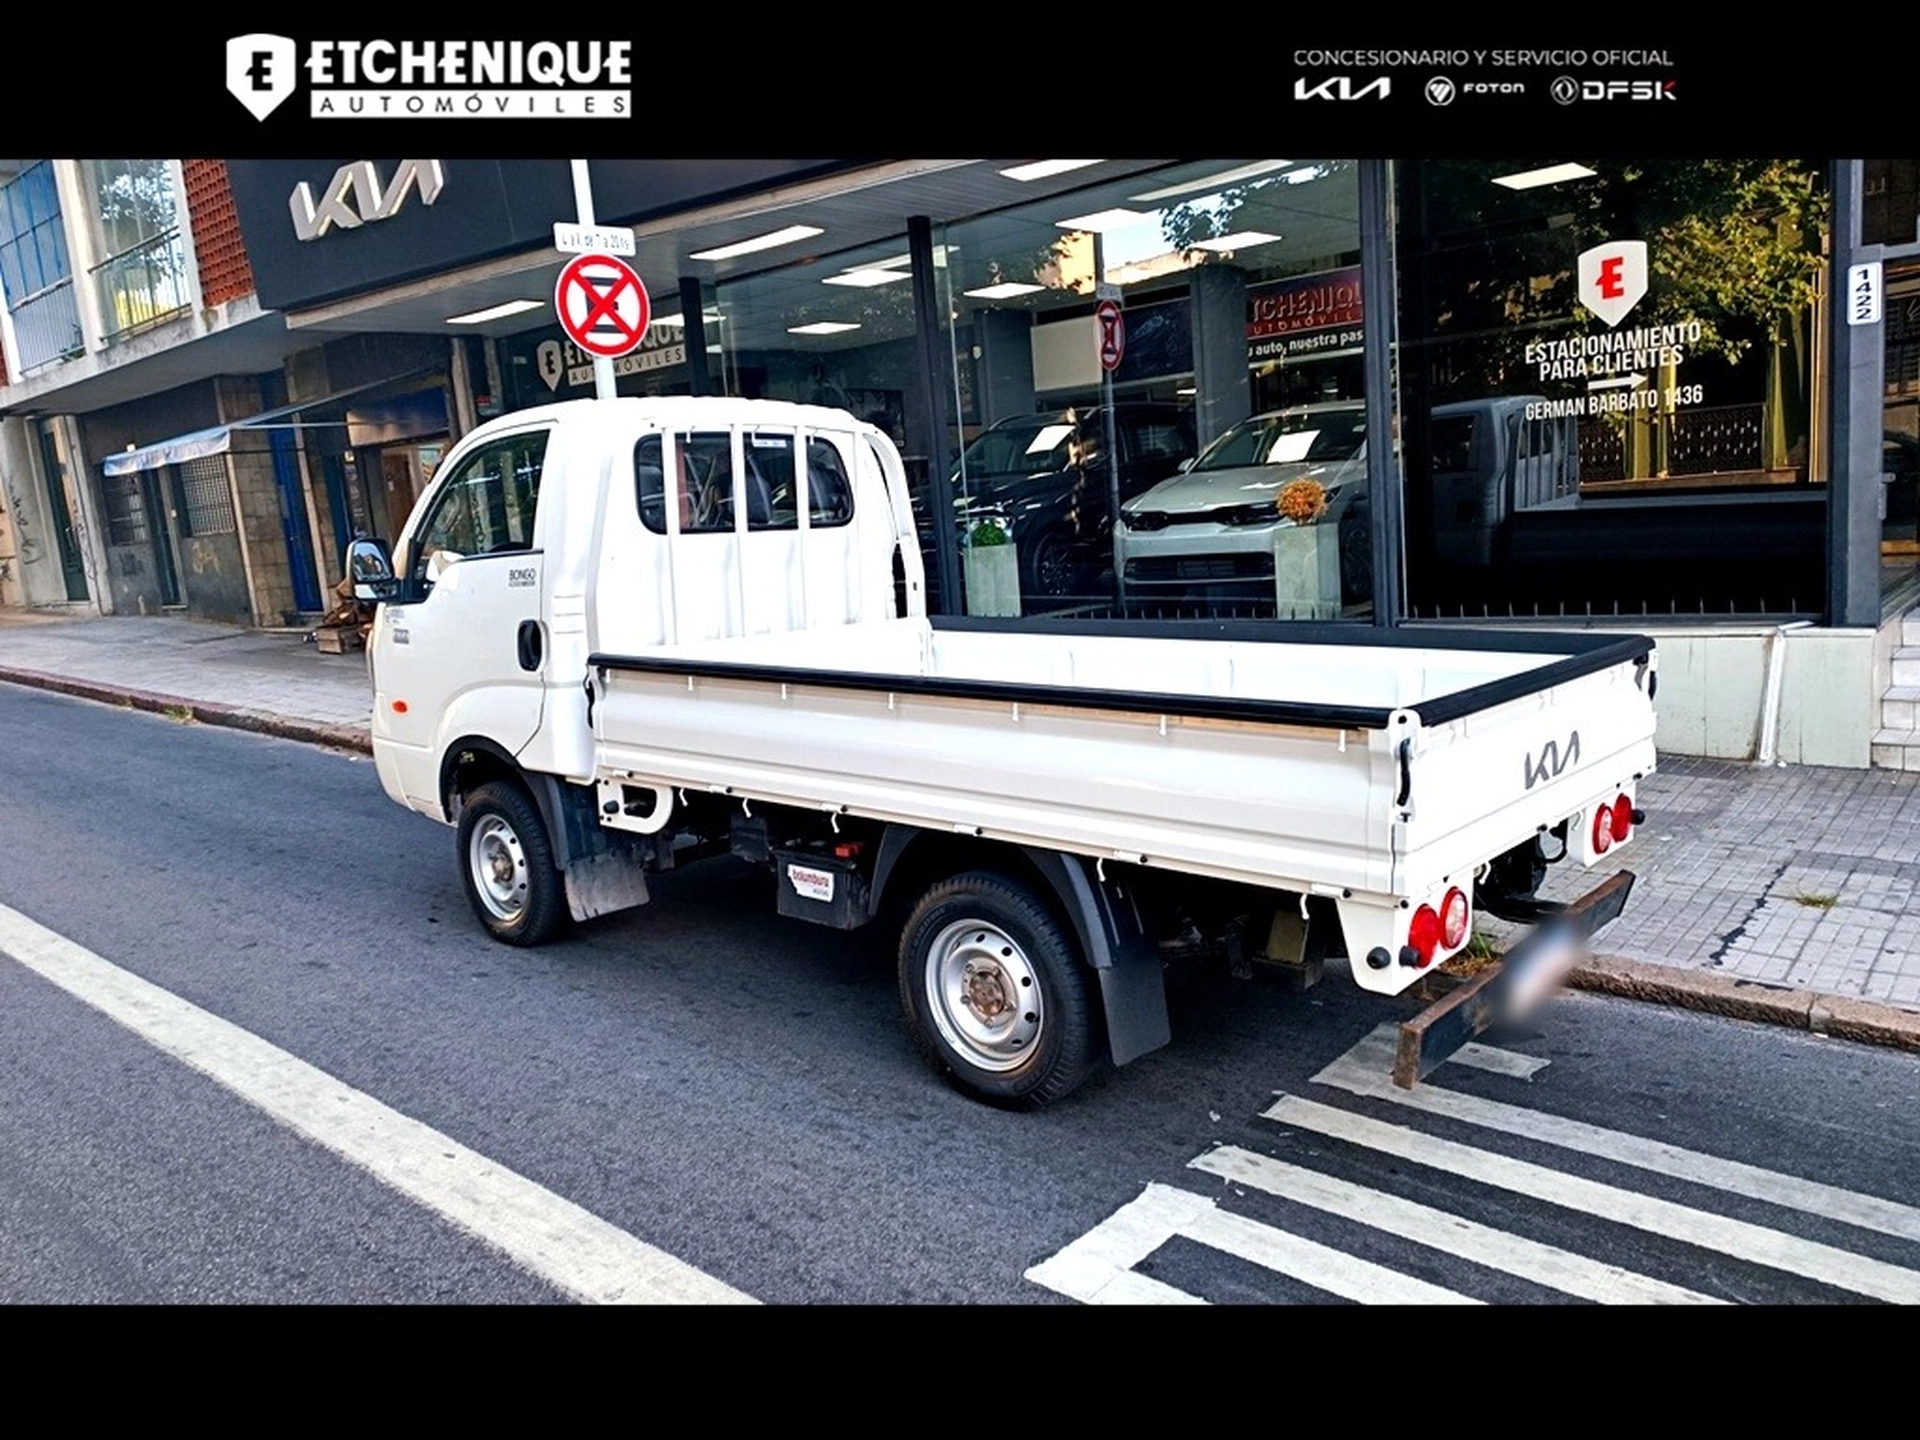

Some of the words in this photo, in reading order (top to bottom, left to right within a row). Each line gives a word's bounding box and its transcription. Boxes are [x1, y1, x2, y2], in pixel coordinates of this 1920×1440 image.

[289, 159, 444, 241] KIA
[1856, 268, 1872, 321] 1422
[1289, 334, 1338, 351] nuestra
[1525, 322, 1701, 365] ESTACIONAMIENTO
[1540, 358, 1587, 382] PARA
[1593, 345, 1684, 376] CLIENTES
[1525, 397, 1585, 421] GERMAN
[1589, 389, 1658, 415] BARBATO
[1665, 384, 1703, 407] 1436
[1524, 730, 1580, 790] KIA
